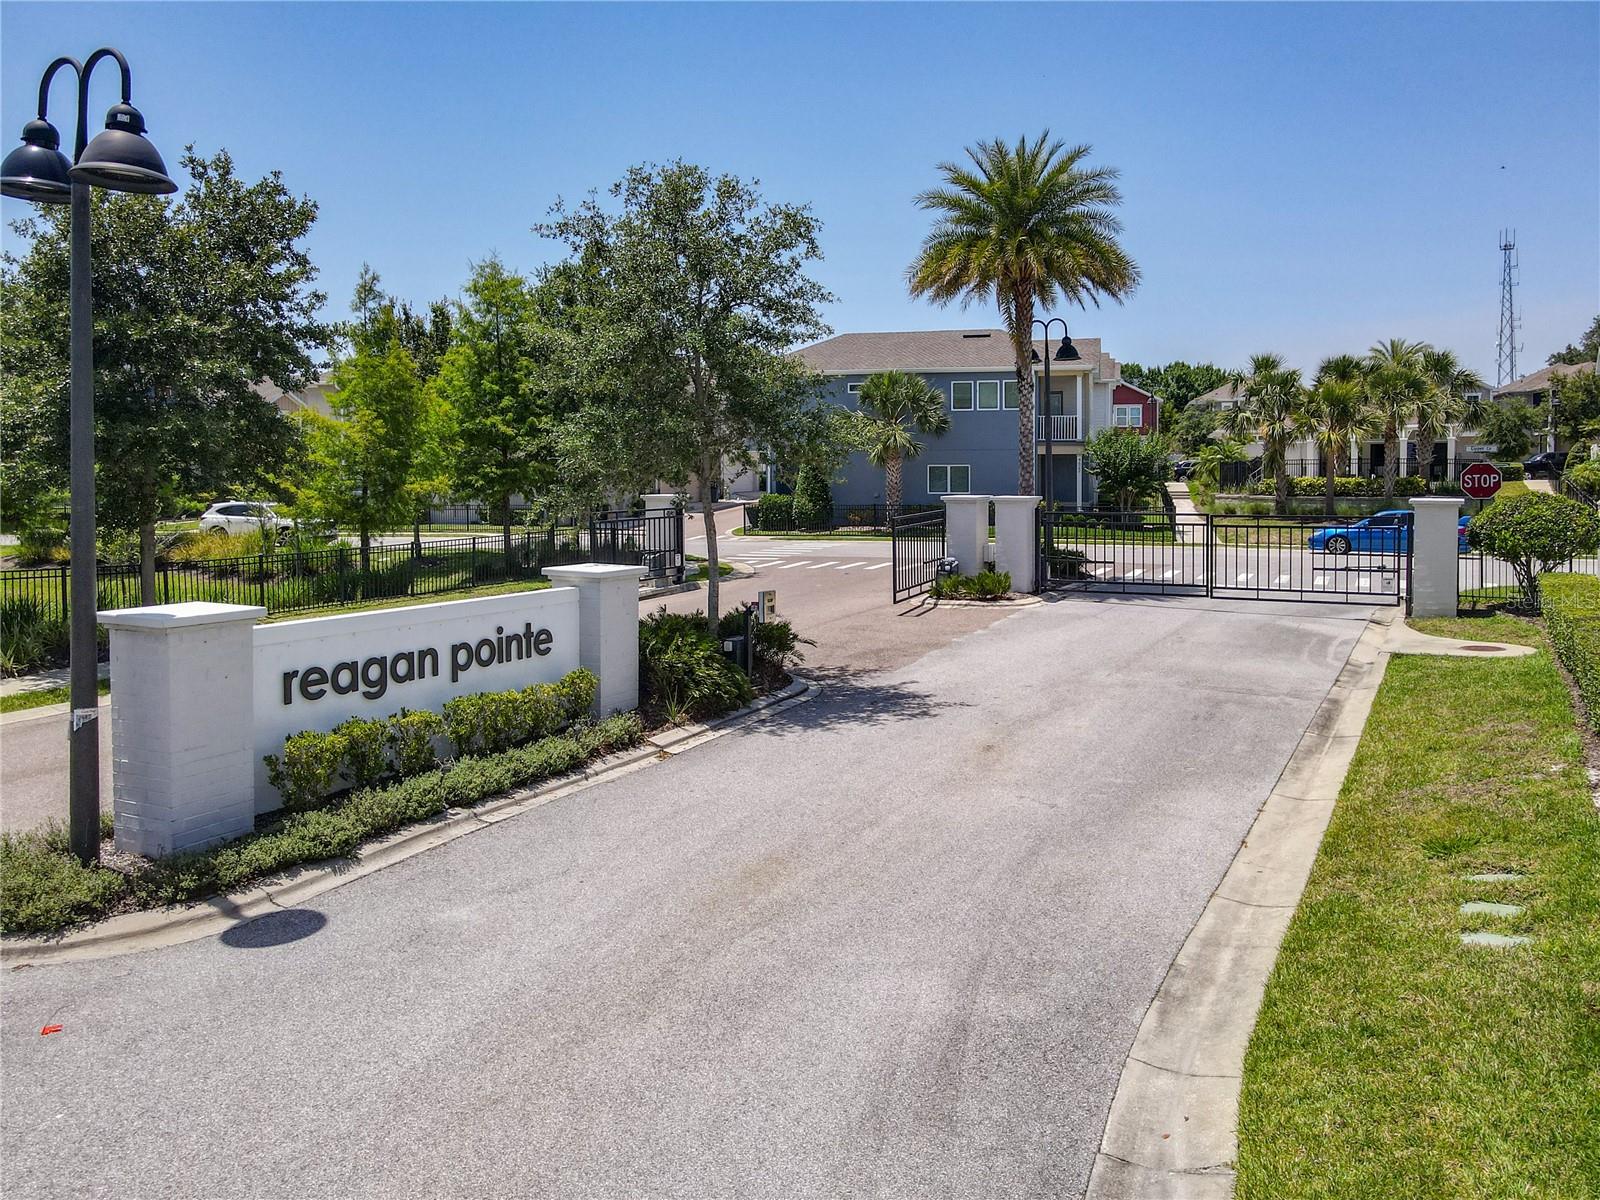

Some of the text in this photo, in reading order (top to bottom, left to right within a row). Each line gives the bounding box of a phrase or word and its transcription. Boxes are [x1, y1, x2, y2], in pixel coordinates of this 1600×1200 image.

[1463, 474, 1499, 488] STOP
[283, 623, 553, 705] reagan pointe
